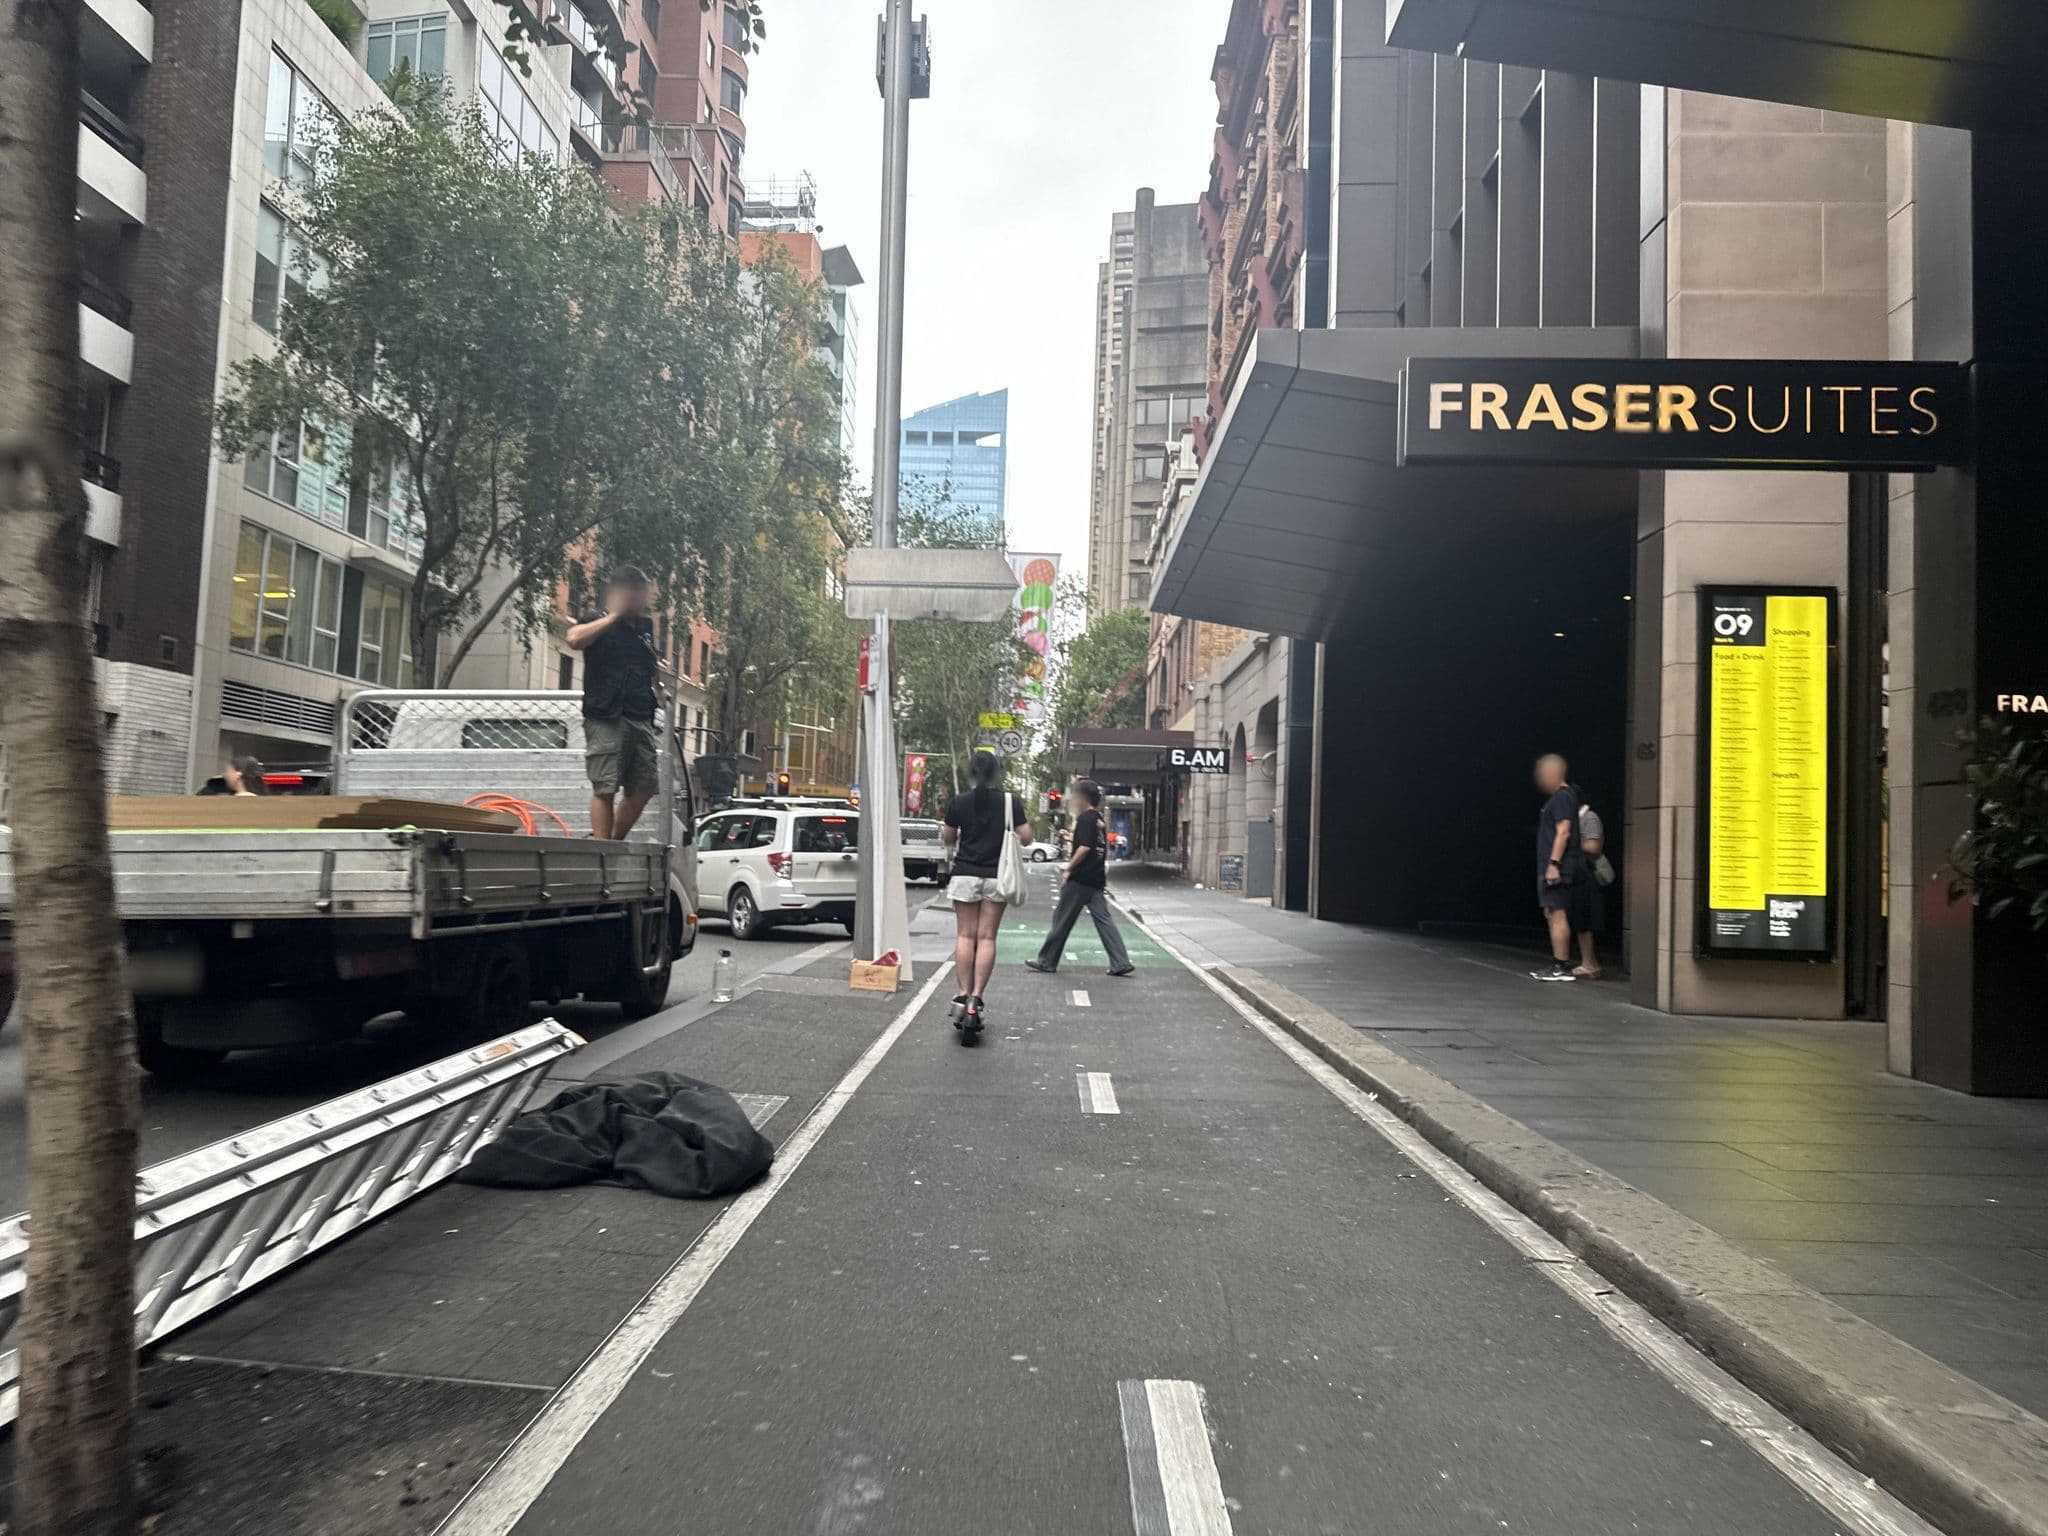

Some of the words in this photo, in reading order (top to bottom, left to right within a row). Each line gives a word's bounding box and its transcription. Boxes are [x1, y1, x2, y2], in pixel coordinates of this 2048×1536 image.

[1428, 382, 1700, 433] FRASER
[1709, 384, 1938, 436] SUITES
[1714, 613, 1753, 635] 09
[1772, 628, 1810, 637] Shopping
[1714, 652, 1734, 660] Food
[1997, 694, 2048, 713] FRA
[1003, 737, 1018, 748] 40
[1171, 749, 1224, 767] 6.AM
